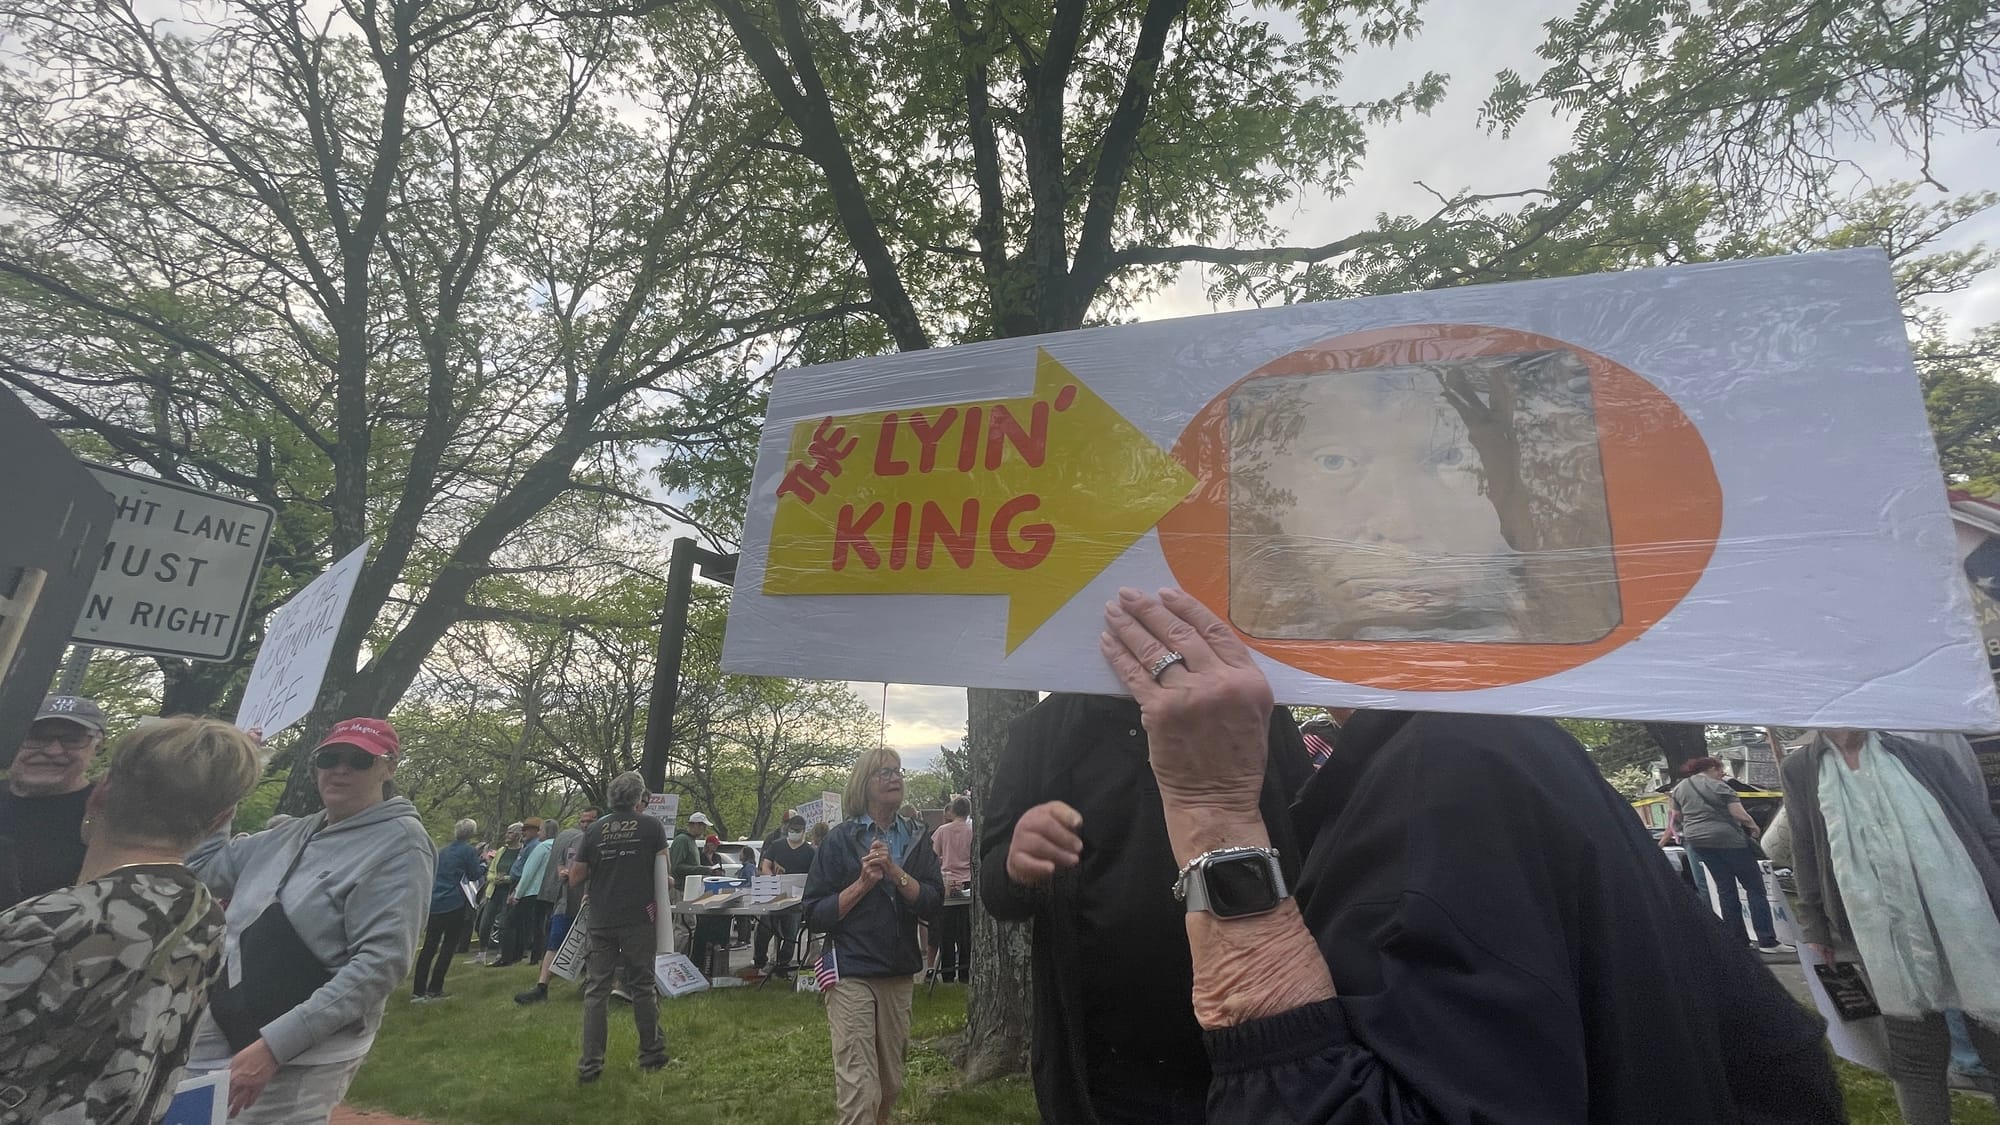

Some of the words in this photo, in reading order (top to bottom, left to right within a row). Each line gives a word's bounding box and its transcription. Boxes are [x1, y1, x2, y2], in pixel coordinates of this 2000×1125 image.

[776, 415, 858, 504] THE
[873, 384, 1077, 476] LYIN'
[117, 496, 161, 525] HT
[173, 509, 256, 547] LANE
[831, 493, 1056, 571] KING
[86, 594, 113, 621] N
[129, 601, 230, 637] RIGHT
[267, 660, 292, 698] IN
[556, 929, 585, 971] PUTIN
